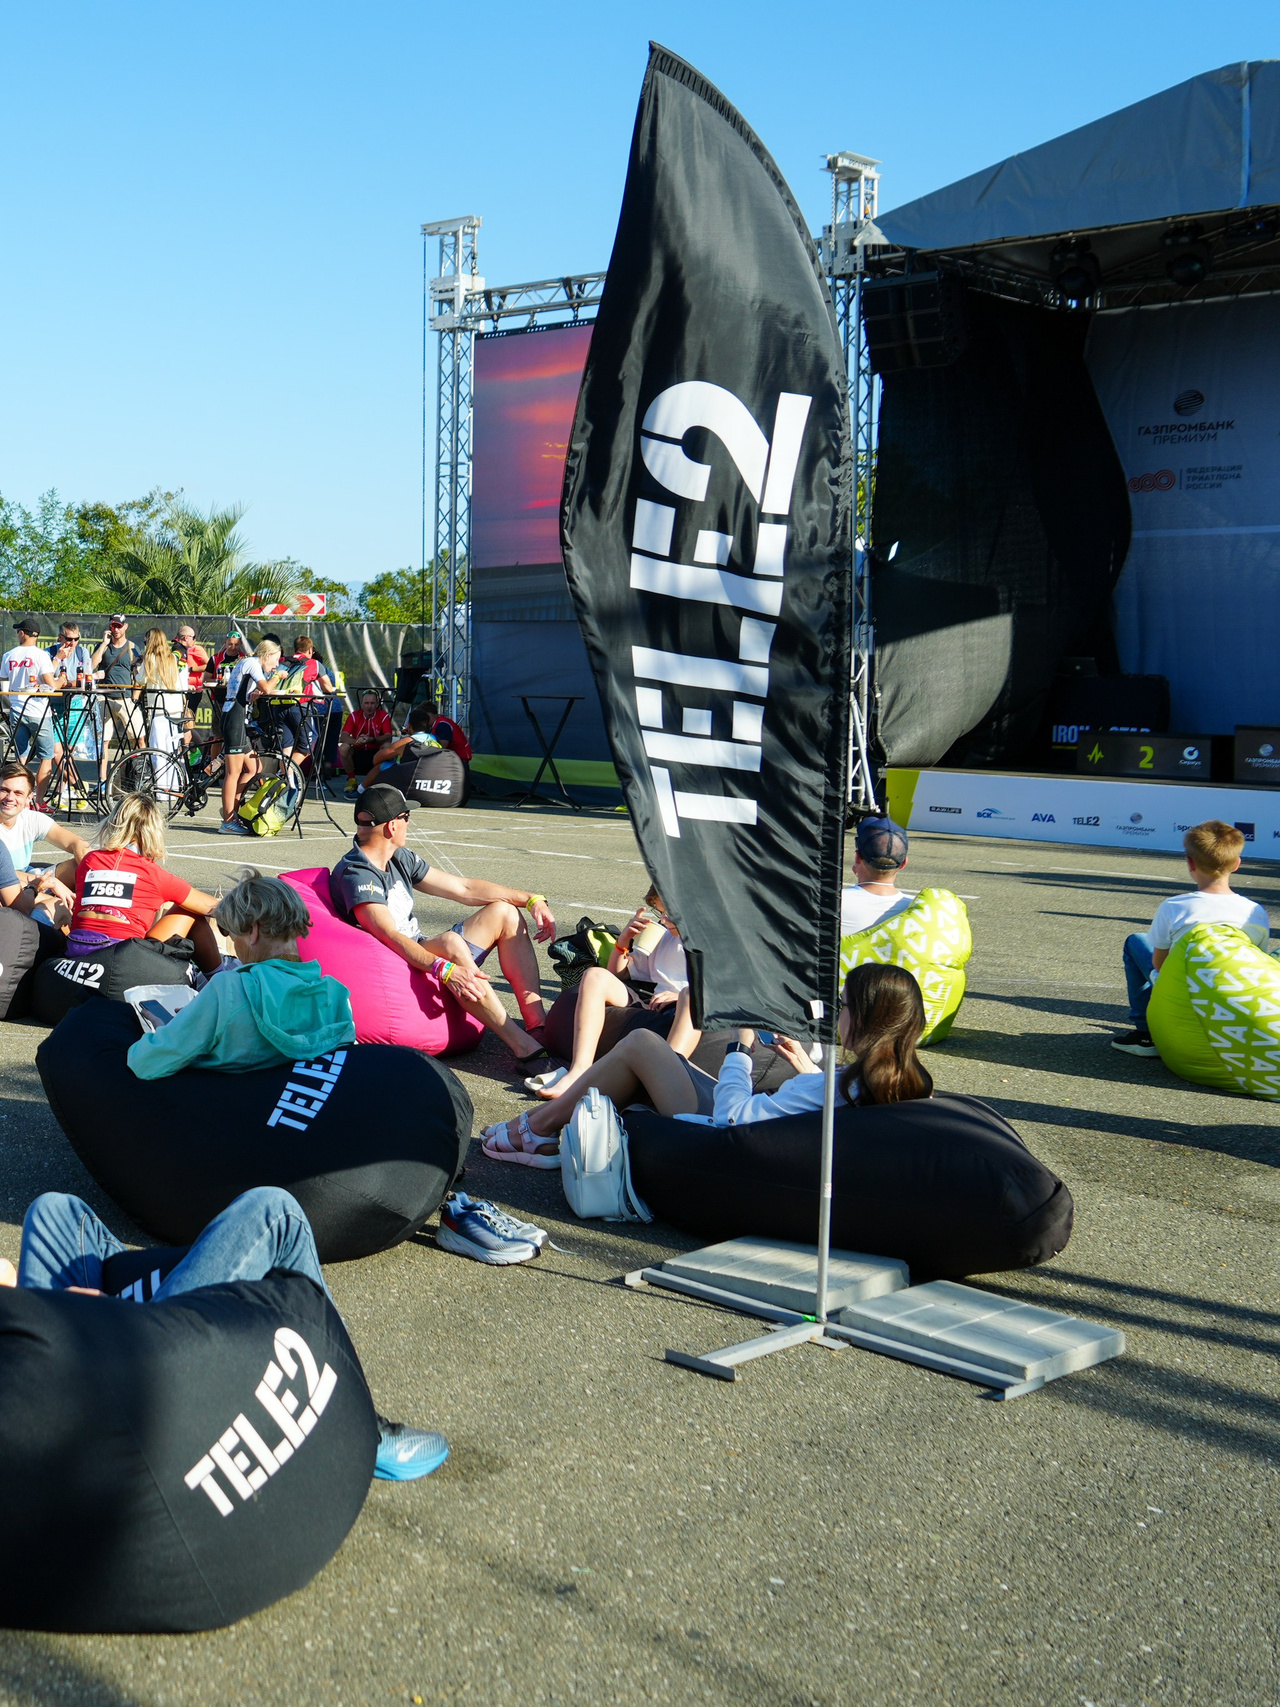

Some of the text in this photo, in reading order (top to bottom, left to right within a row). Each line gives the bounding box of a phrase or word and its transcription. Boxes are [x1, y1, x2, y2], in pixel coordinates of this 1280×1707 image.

[1138, 420, 1235, 436] ГАЗПРОМБАНК
[1153, 432, 1217, 445] ПРЕМИУМ
[1186, 464, 1243, 474] ФЕДЕРАЦИЯ
[1186, 473, 1241, 482] ТРИАТЛОНА
[1186, 482, 1222, 490] РОССИИ
[630, 381, 812, 838] TELE2
[1139, 746, 1154, 769] 2
[1179, 759, 1202, 767] Сириус
[1245, 757, 1280, 766] ГАЗПРОМБАН
[415, 779, 452, 795] TELE2
[1031, 813, 1056, 823] AVA
[1073, 816, 1100, 826] TELE2
[90, 883, 124, 897] 7568
[53, 959, 105, 989] TELE2
[184, 1326, 338, 1517] TELE2
